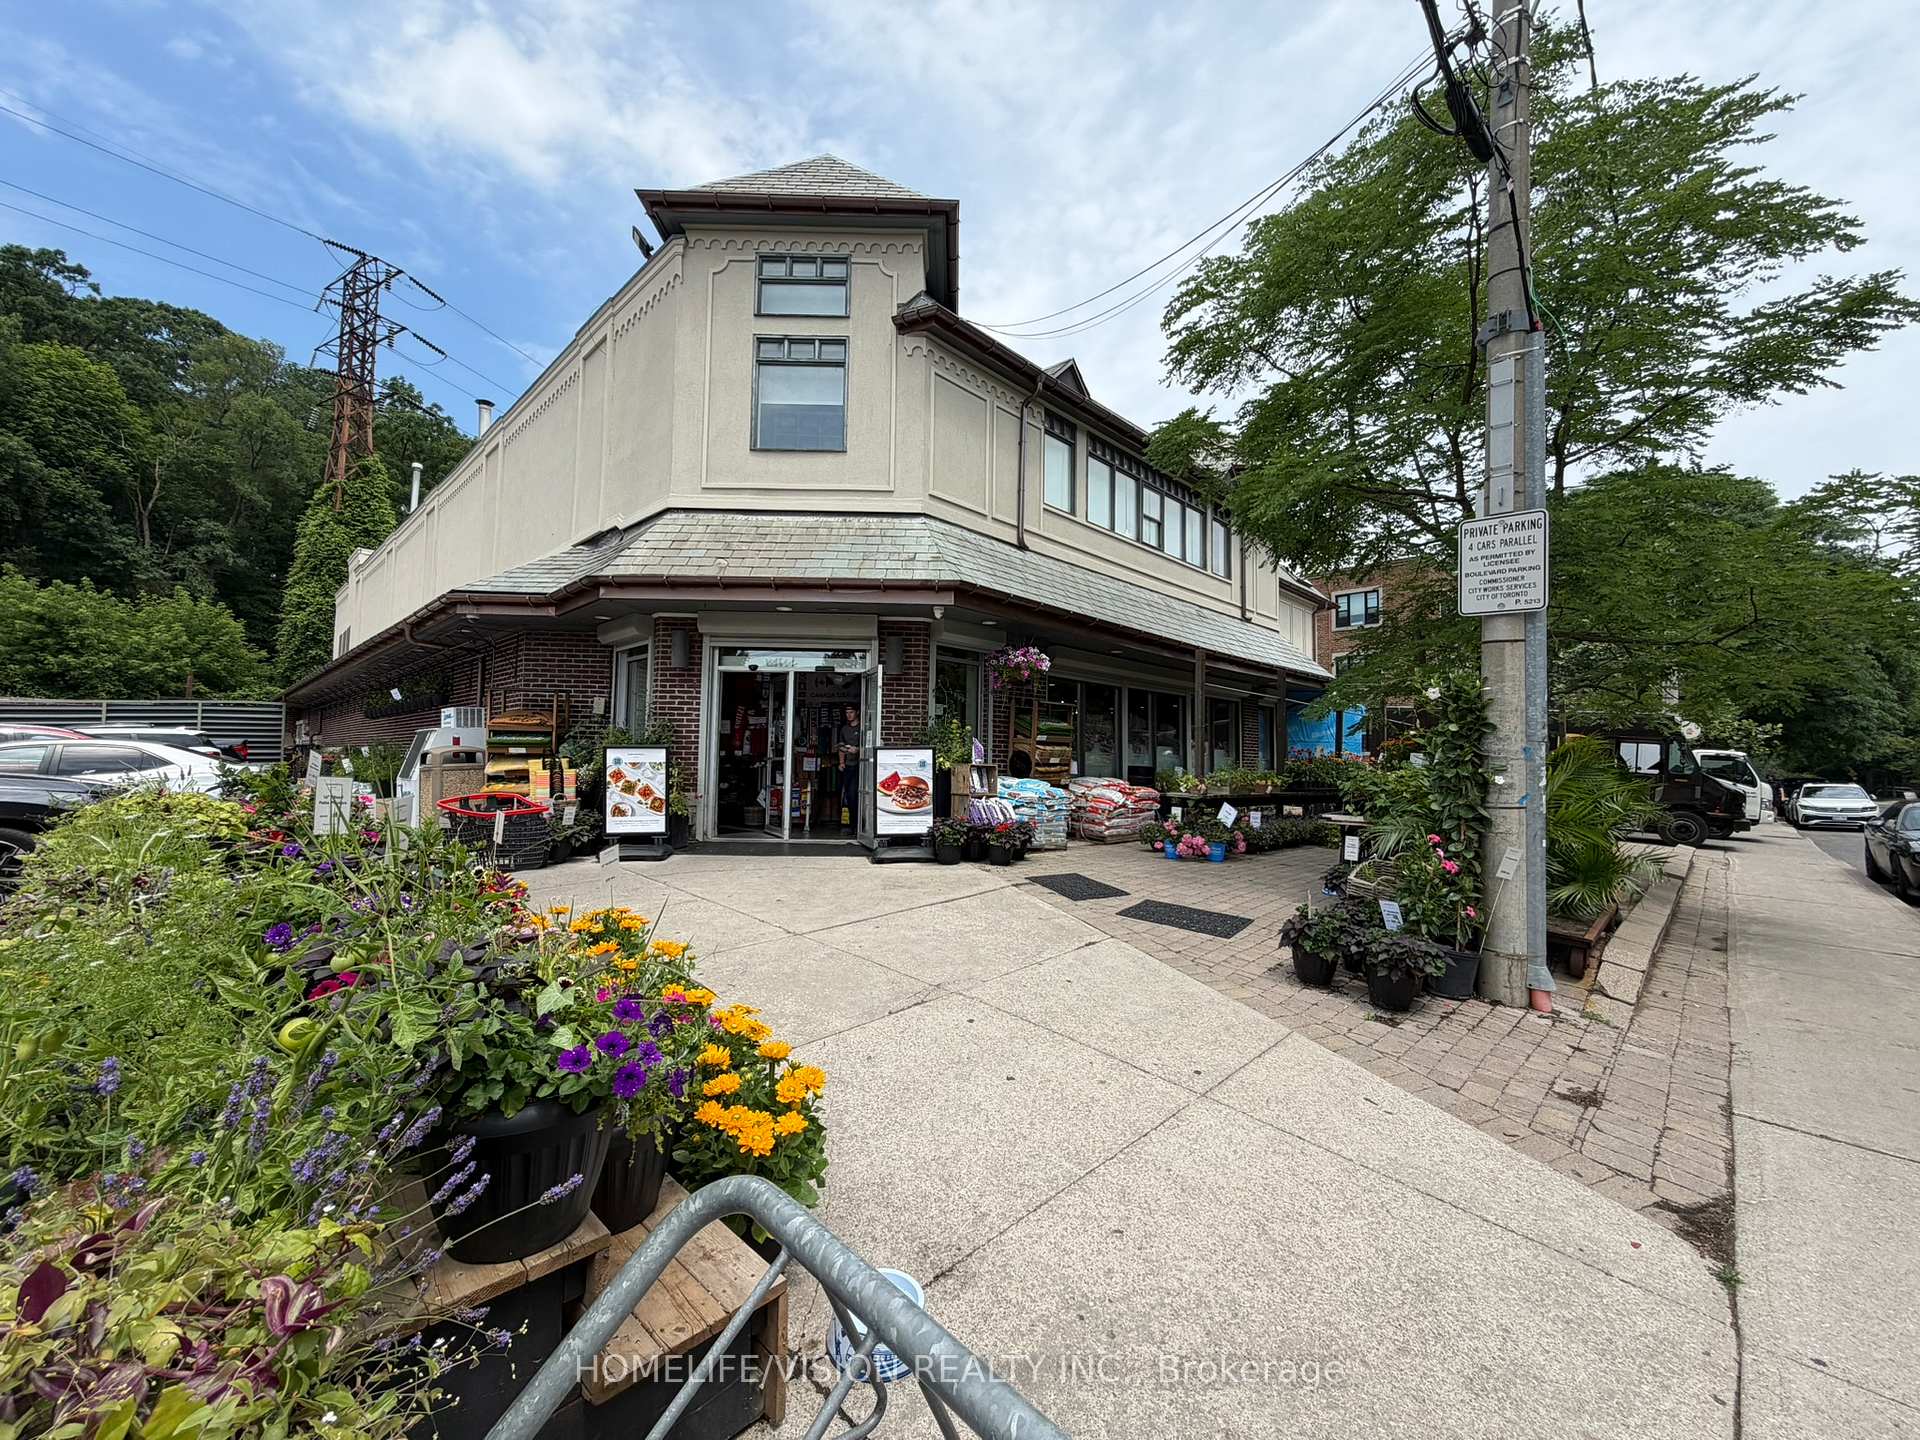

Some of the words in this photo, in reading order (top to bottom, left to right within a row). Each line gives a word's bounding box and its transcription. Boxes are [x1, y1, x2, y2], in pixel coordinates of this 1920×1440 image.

[1463, 525, 1499, 539] PRIVATE
[1502, 518, 1543, 534] PARKING
[1468, 543, 1474, 551] 4
[1476, 540, 1496, 551] CARS
[1499, 535, 1538, 548] PARALLEL
[1480, 551, 1524, 561] PERMITTED
[1483, 558, 1521, 568] LICENSEE
[1464, 569, 1507, 578] BOULEVARD
[1508, 565, 1541, 573] PARKING
[1479, 575, 1526, 586] COMMISSIONER
[1483, 585, 1504, 593] WORKS
[1506, 582, 1537, 591] SERVICES
[1499, 591, 1529, 599] TORONTO
